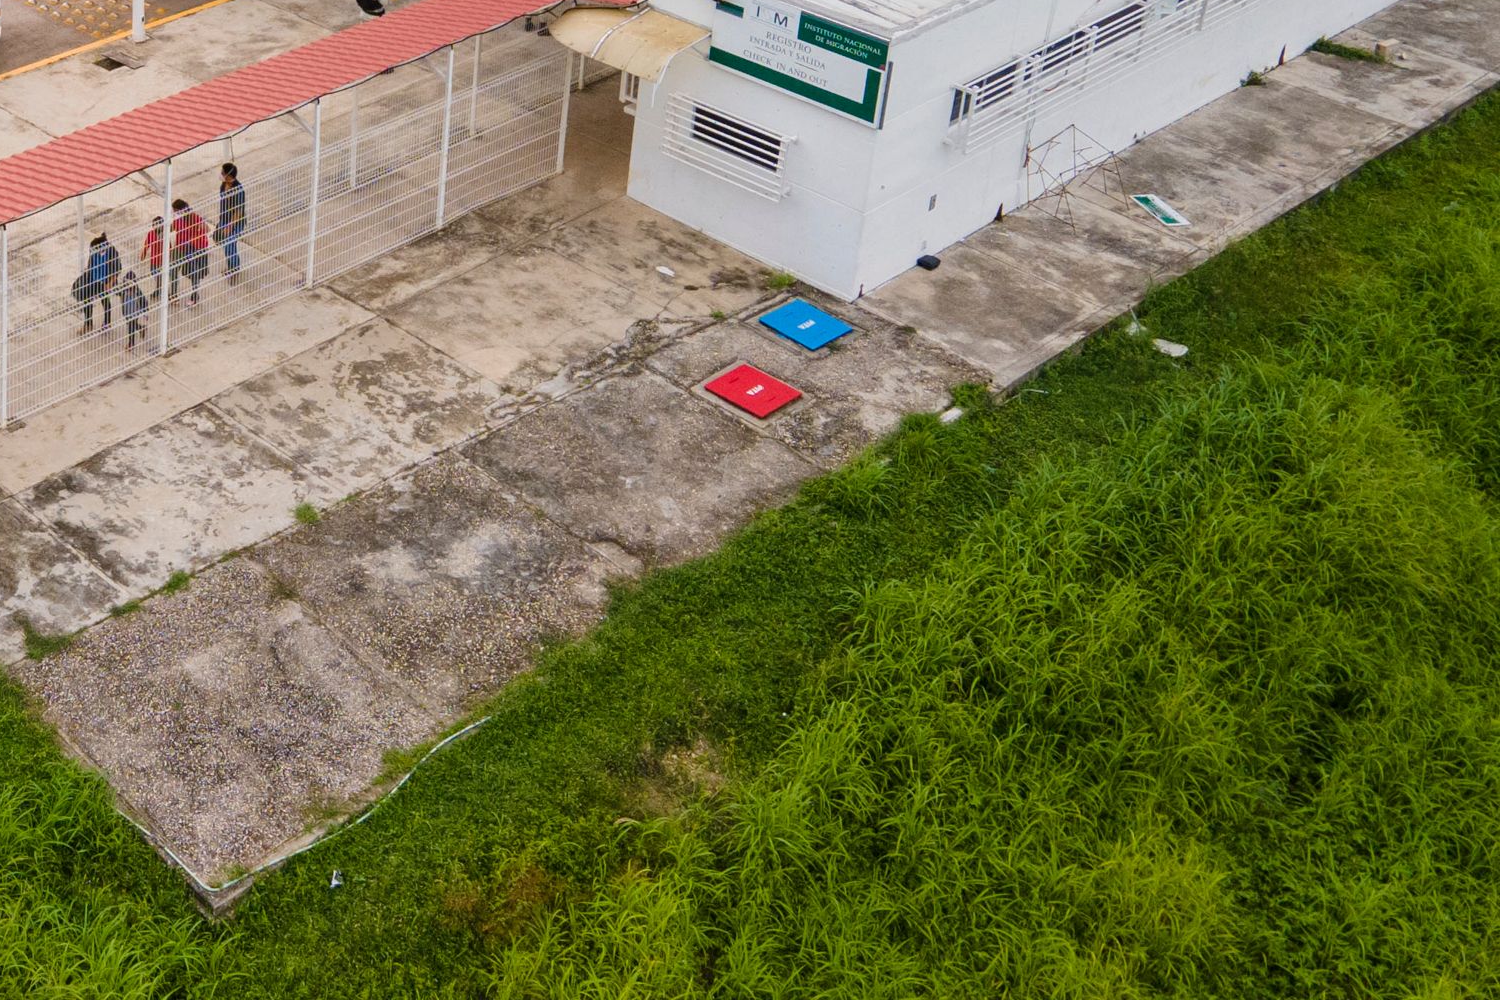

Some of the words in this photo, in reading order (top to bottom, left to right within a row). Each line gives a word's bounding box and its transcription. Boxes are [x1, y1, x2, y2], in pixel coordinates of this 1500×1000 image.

[749, 35, 786, 55] ENTRADA
[796, 52, 826, 70] SALIDA
[766, 31, 812, 54] REGISTRO
[804, 22, 843, 41] INSTITUTO
[844, 37, 882, 56] NACIONAL
[815, 34, 825, 43] DE
[743, 49, 773, 66] CHECK
[776, 62, 786, 71] IN
[788, 67, 808, 79] AND
[808, 74, 829, 87] OUT
